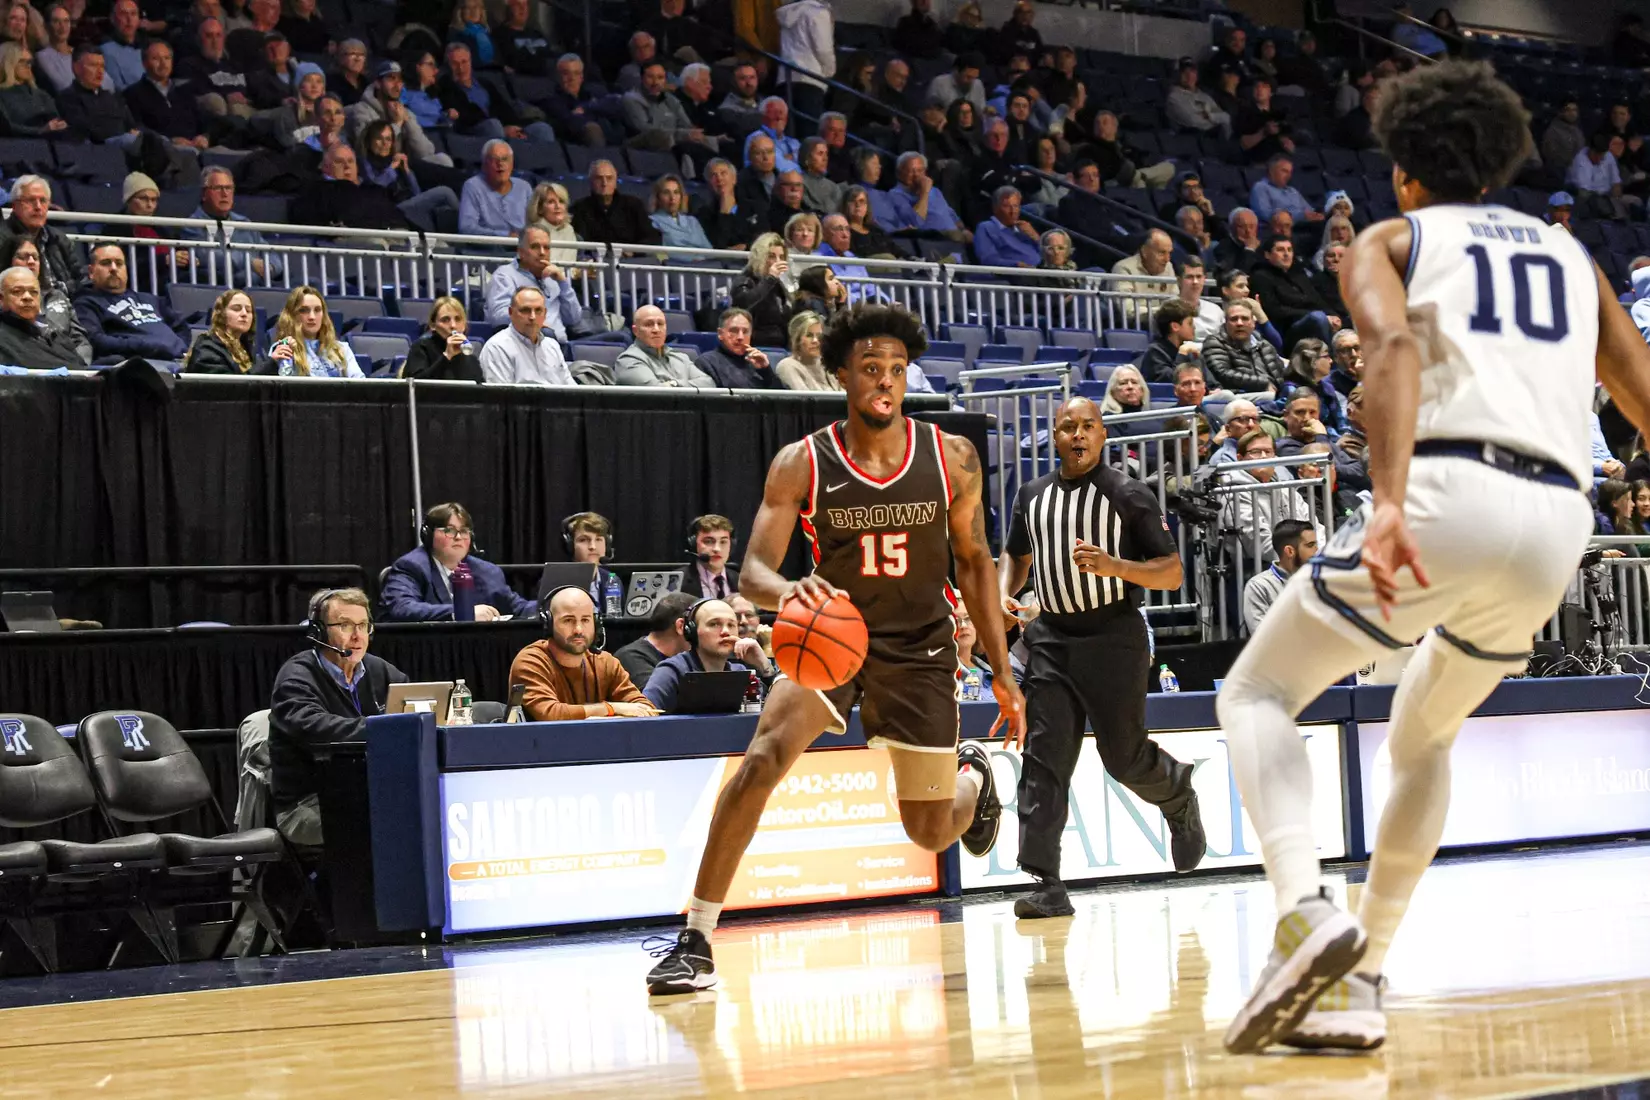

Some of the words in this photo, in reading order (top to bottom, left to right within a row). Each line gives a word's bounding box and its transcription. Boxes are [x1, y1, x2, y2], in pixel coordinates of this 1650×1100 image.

[1465, 243, 1569, 343] 10
[827, 501, 938, 529] BROWN
[860, 531, 909, 577] 15
[447, 795, 600, 861] SANTORO
[612, 790, 664, 848] OIL
[476, 865, 488, 877] A
[488, 860, 528, 876] TOTAL
[581, 852, 642, 869] COMPANY
